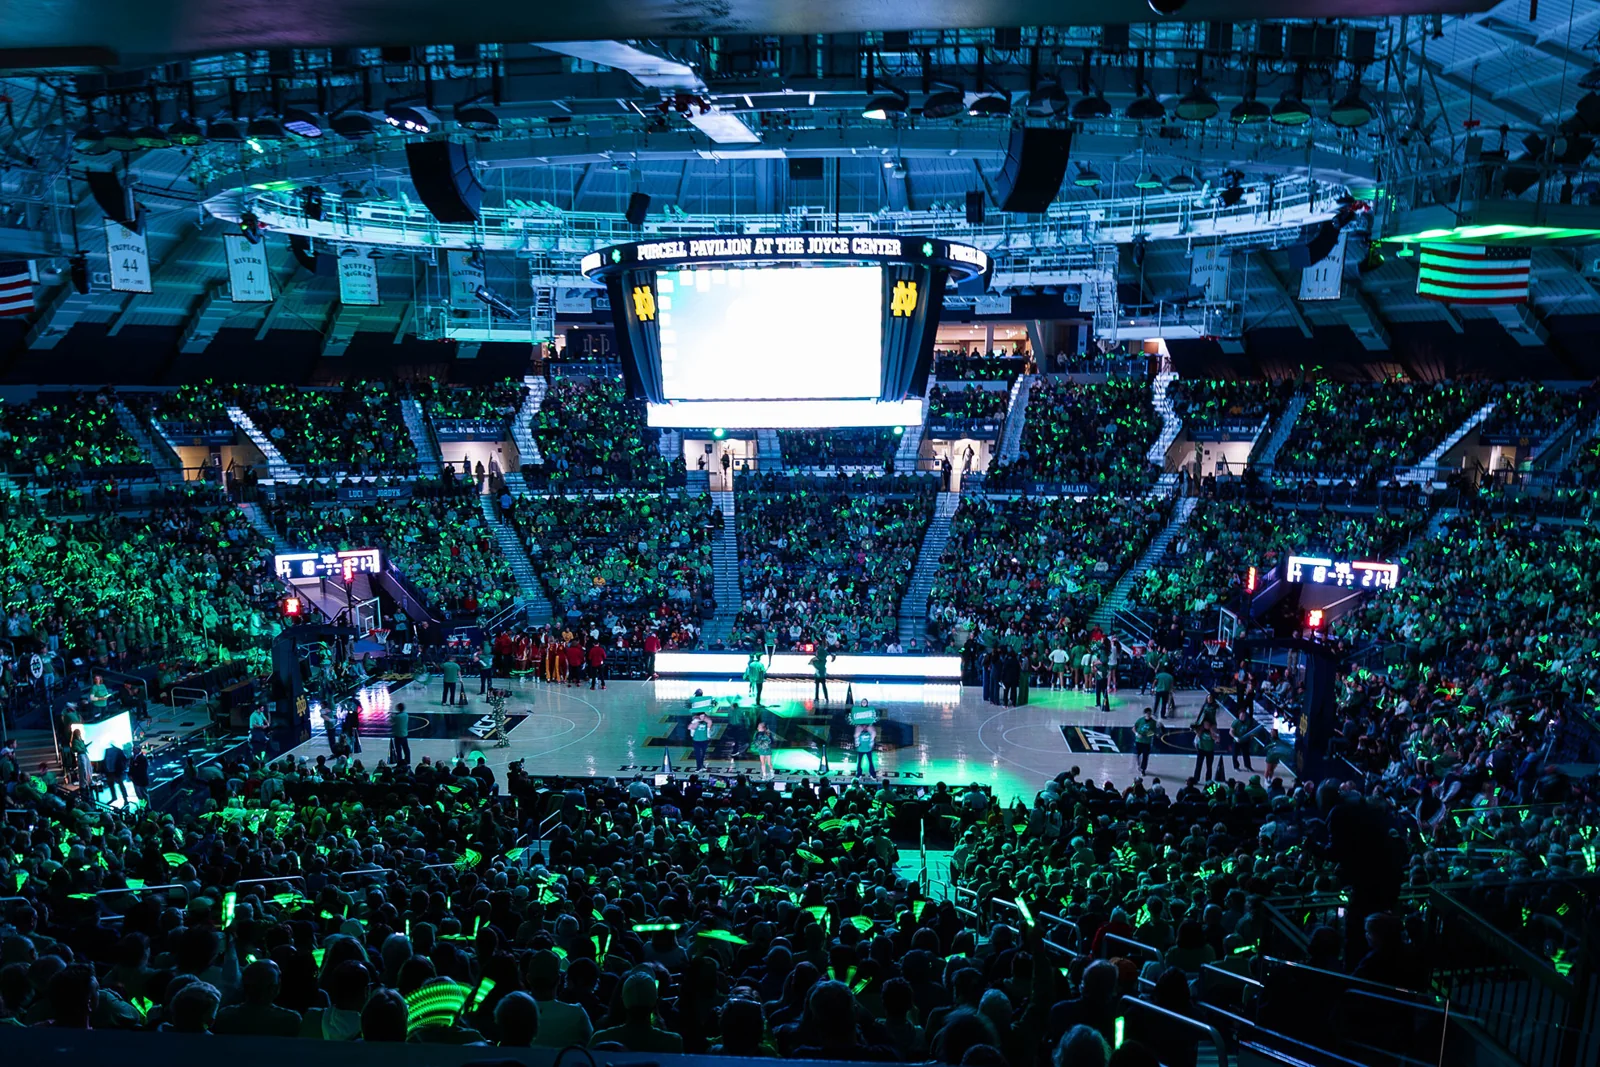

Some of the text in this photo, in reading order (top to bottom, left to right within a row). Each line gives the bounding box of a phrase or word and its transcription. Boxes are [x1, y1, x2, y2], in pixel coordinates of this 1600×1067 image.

[637, 237, 902, 260] PURCELL PAVILION AT THE JOYCE CENTER
[122, 258, 139, 272] 44
[247, 270, 255, 283] 4
[1315, 268, 1328, 282] 11
[462, 282, 476, 294] 12
[1061, 484, 1088, 493] MALAYA
[773, 769, 924, 779] PAVILON
